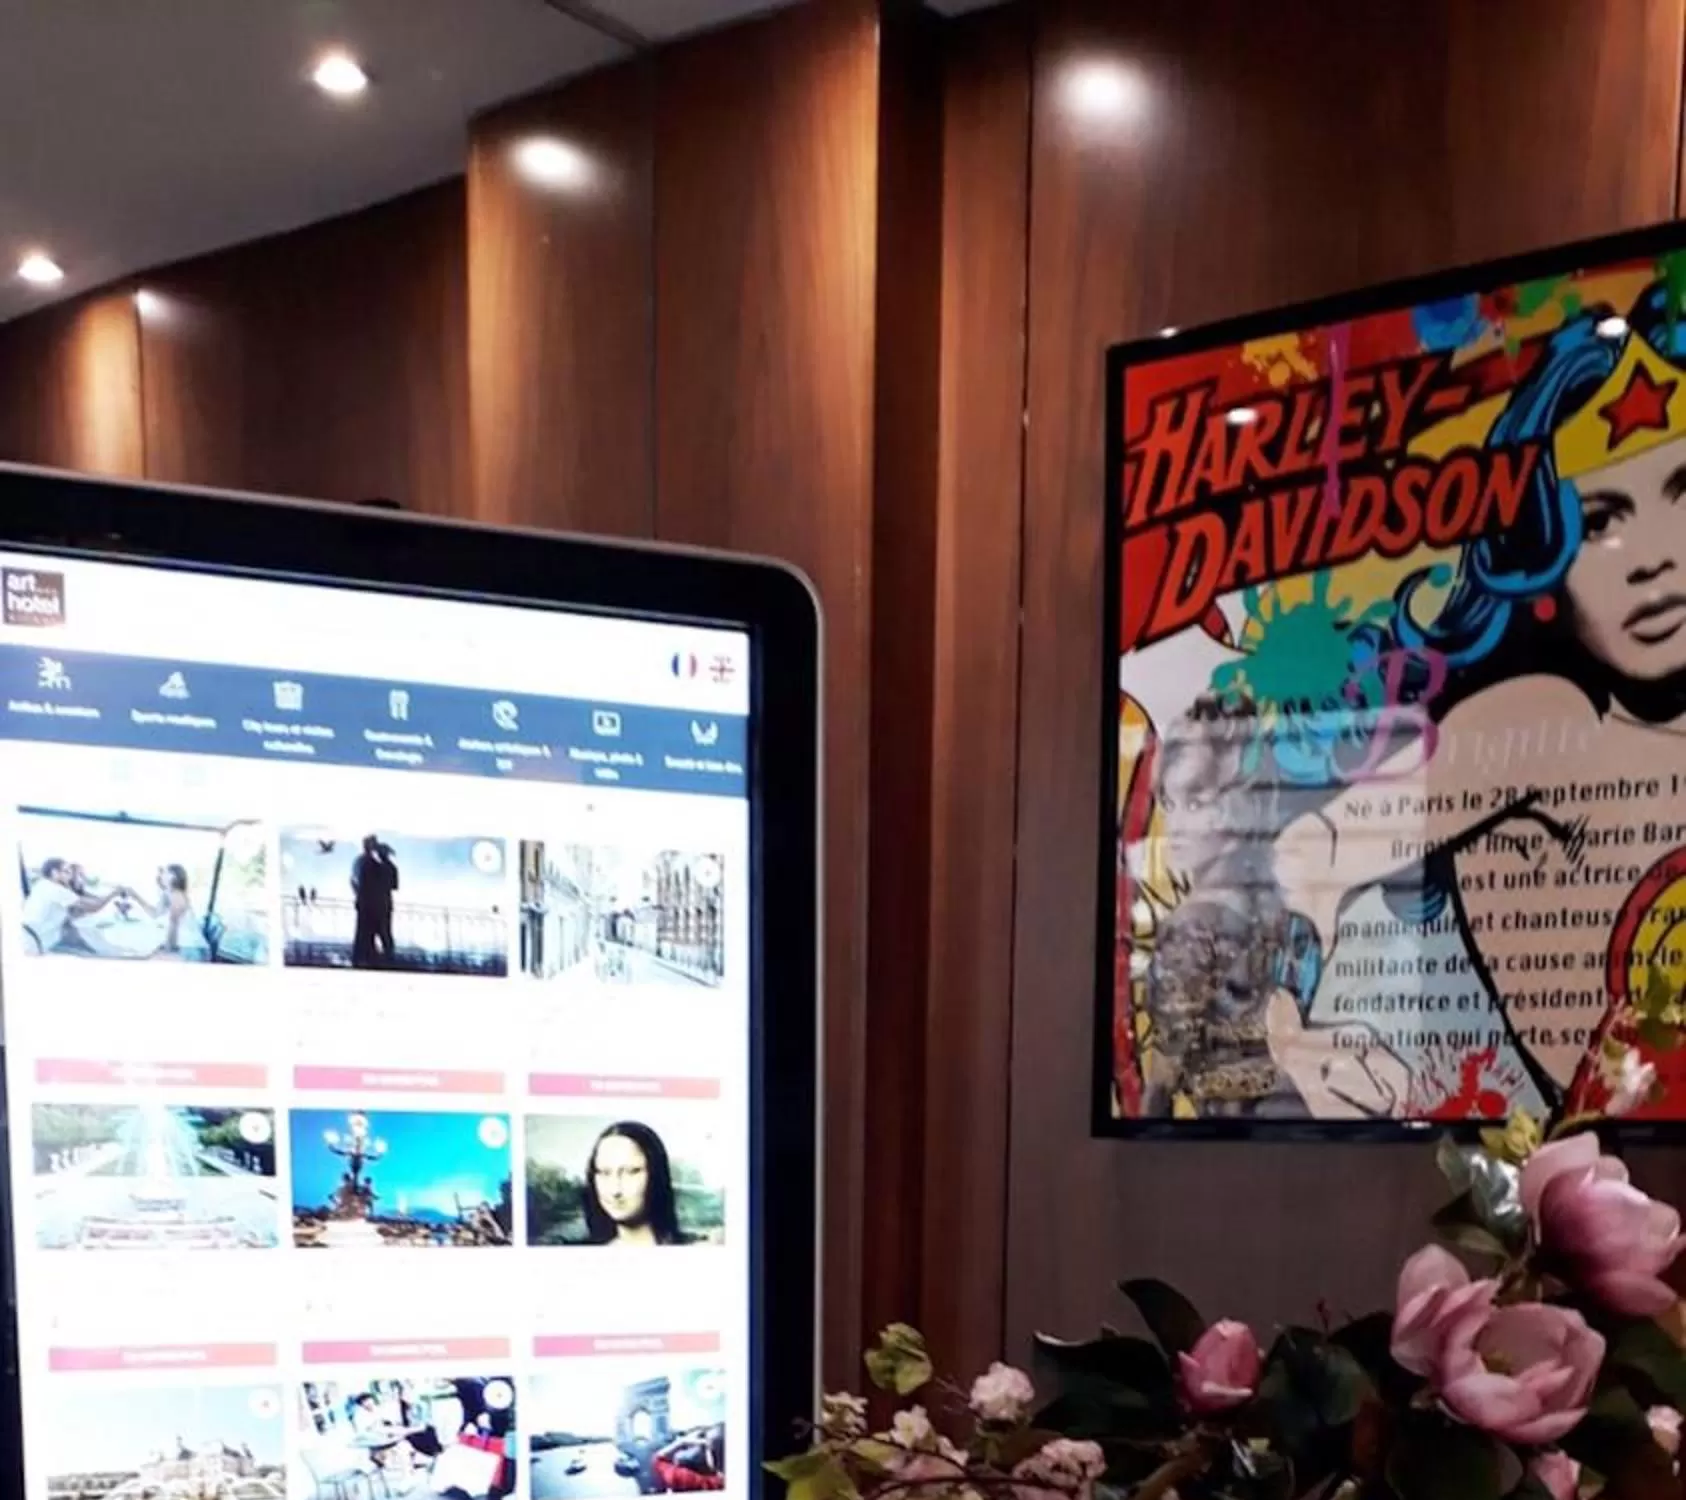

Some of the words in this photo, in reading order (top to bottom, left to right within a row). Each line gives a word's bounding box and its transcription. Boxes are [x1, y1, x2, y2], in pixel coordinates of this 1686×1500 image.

[1143, 443, 1540, 640] DAVIDSON
[1397, 792, 1455, 817] Paris
[1462, 789, 1483, 811] le
[1461, 869, 1497, 891] est
[1504, 867, 1546, 889] une
[1554, 863, 1641, 887] actrice
[1470, 911, 1494, 932] et
[1334, 956, 1437, 978] militante
[1506, 951, 1576, 973] cause
[1333, 990, 1450, 1013] fondatrice
[1457, 989, 1481, 1012] et
[1446, 1028, 1481, 1051] qui
